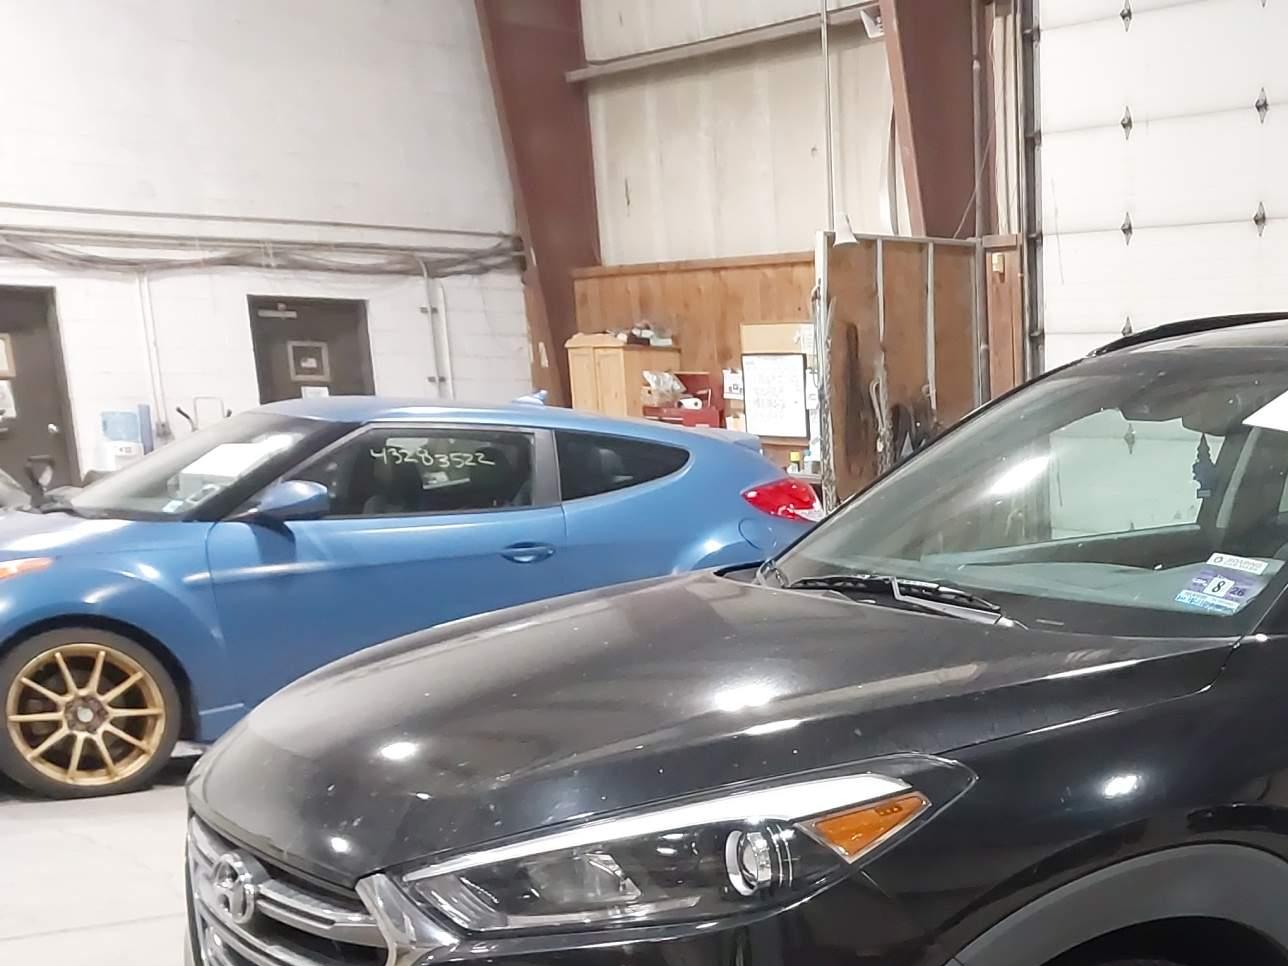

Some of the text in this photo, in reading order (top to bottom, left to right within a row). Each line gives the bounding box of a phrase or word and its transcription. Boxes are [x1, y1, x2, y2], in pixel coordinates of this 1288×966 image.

[370, 447, 496, 469] 43283522
[1211, 580, 1226, 593] 8
[1230, 586, 1246, 597] 26
